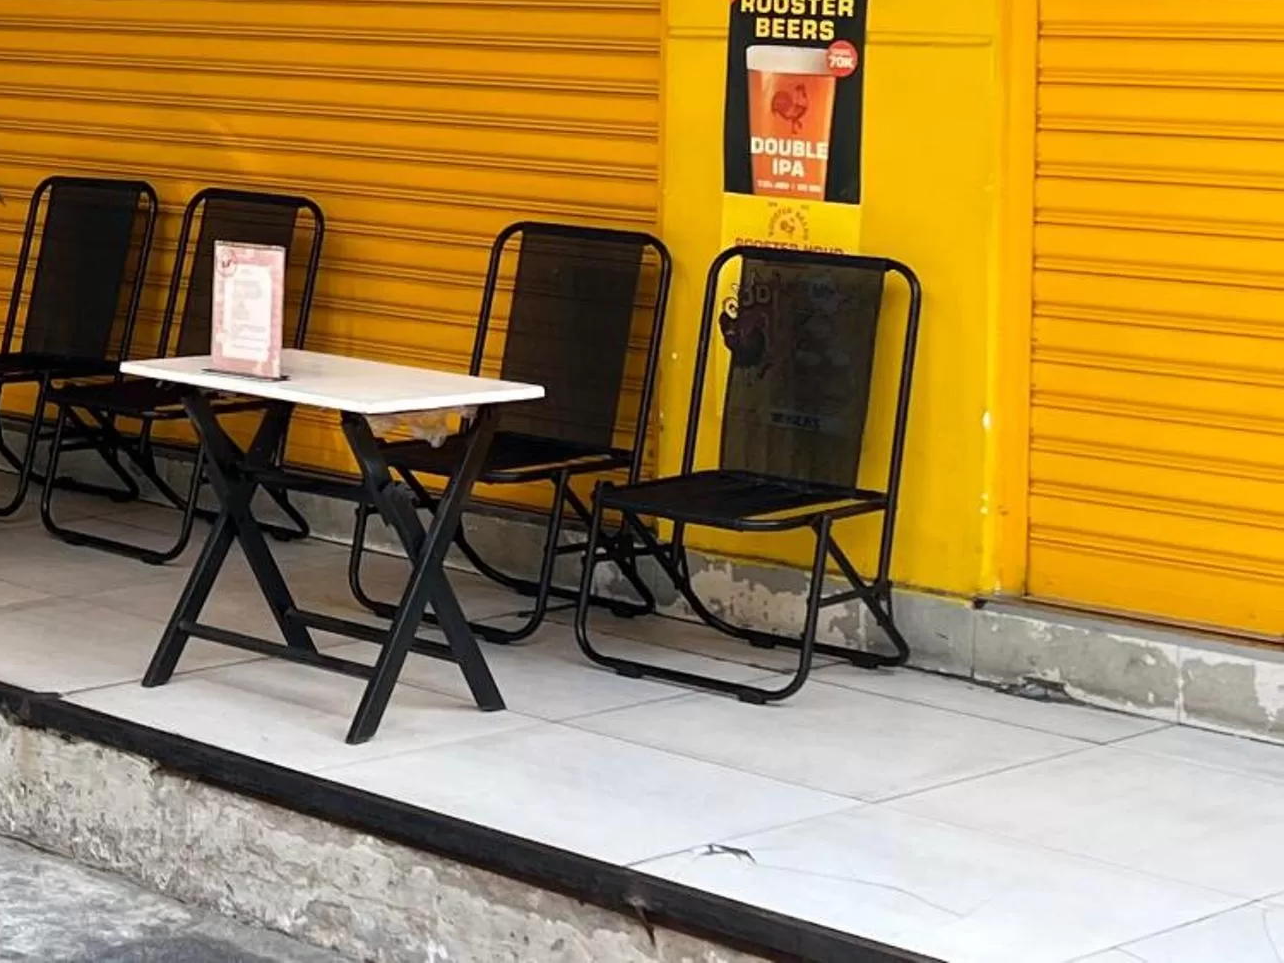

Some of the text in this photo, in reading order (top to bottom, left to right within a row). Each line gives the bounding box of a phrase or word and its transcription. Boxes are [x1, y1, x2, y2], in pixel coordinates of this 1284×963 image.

[755, 17, 835, 41] BEERS
[750, 136, 829, 160] DOUBLE
[771, 157, 804, 178] IPA
